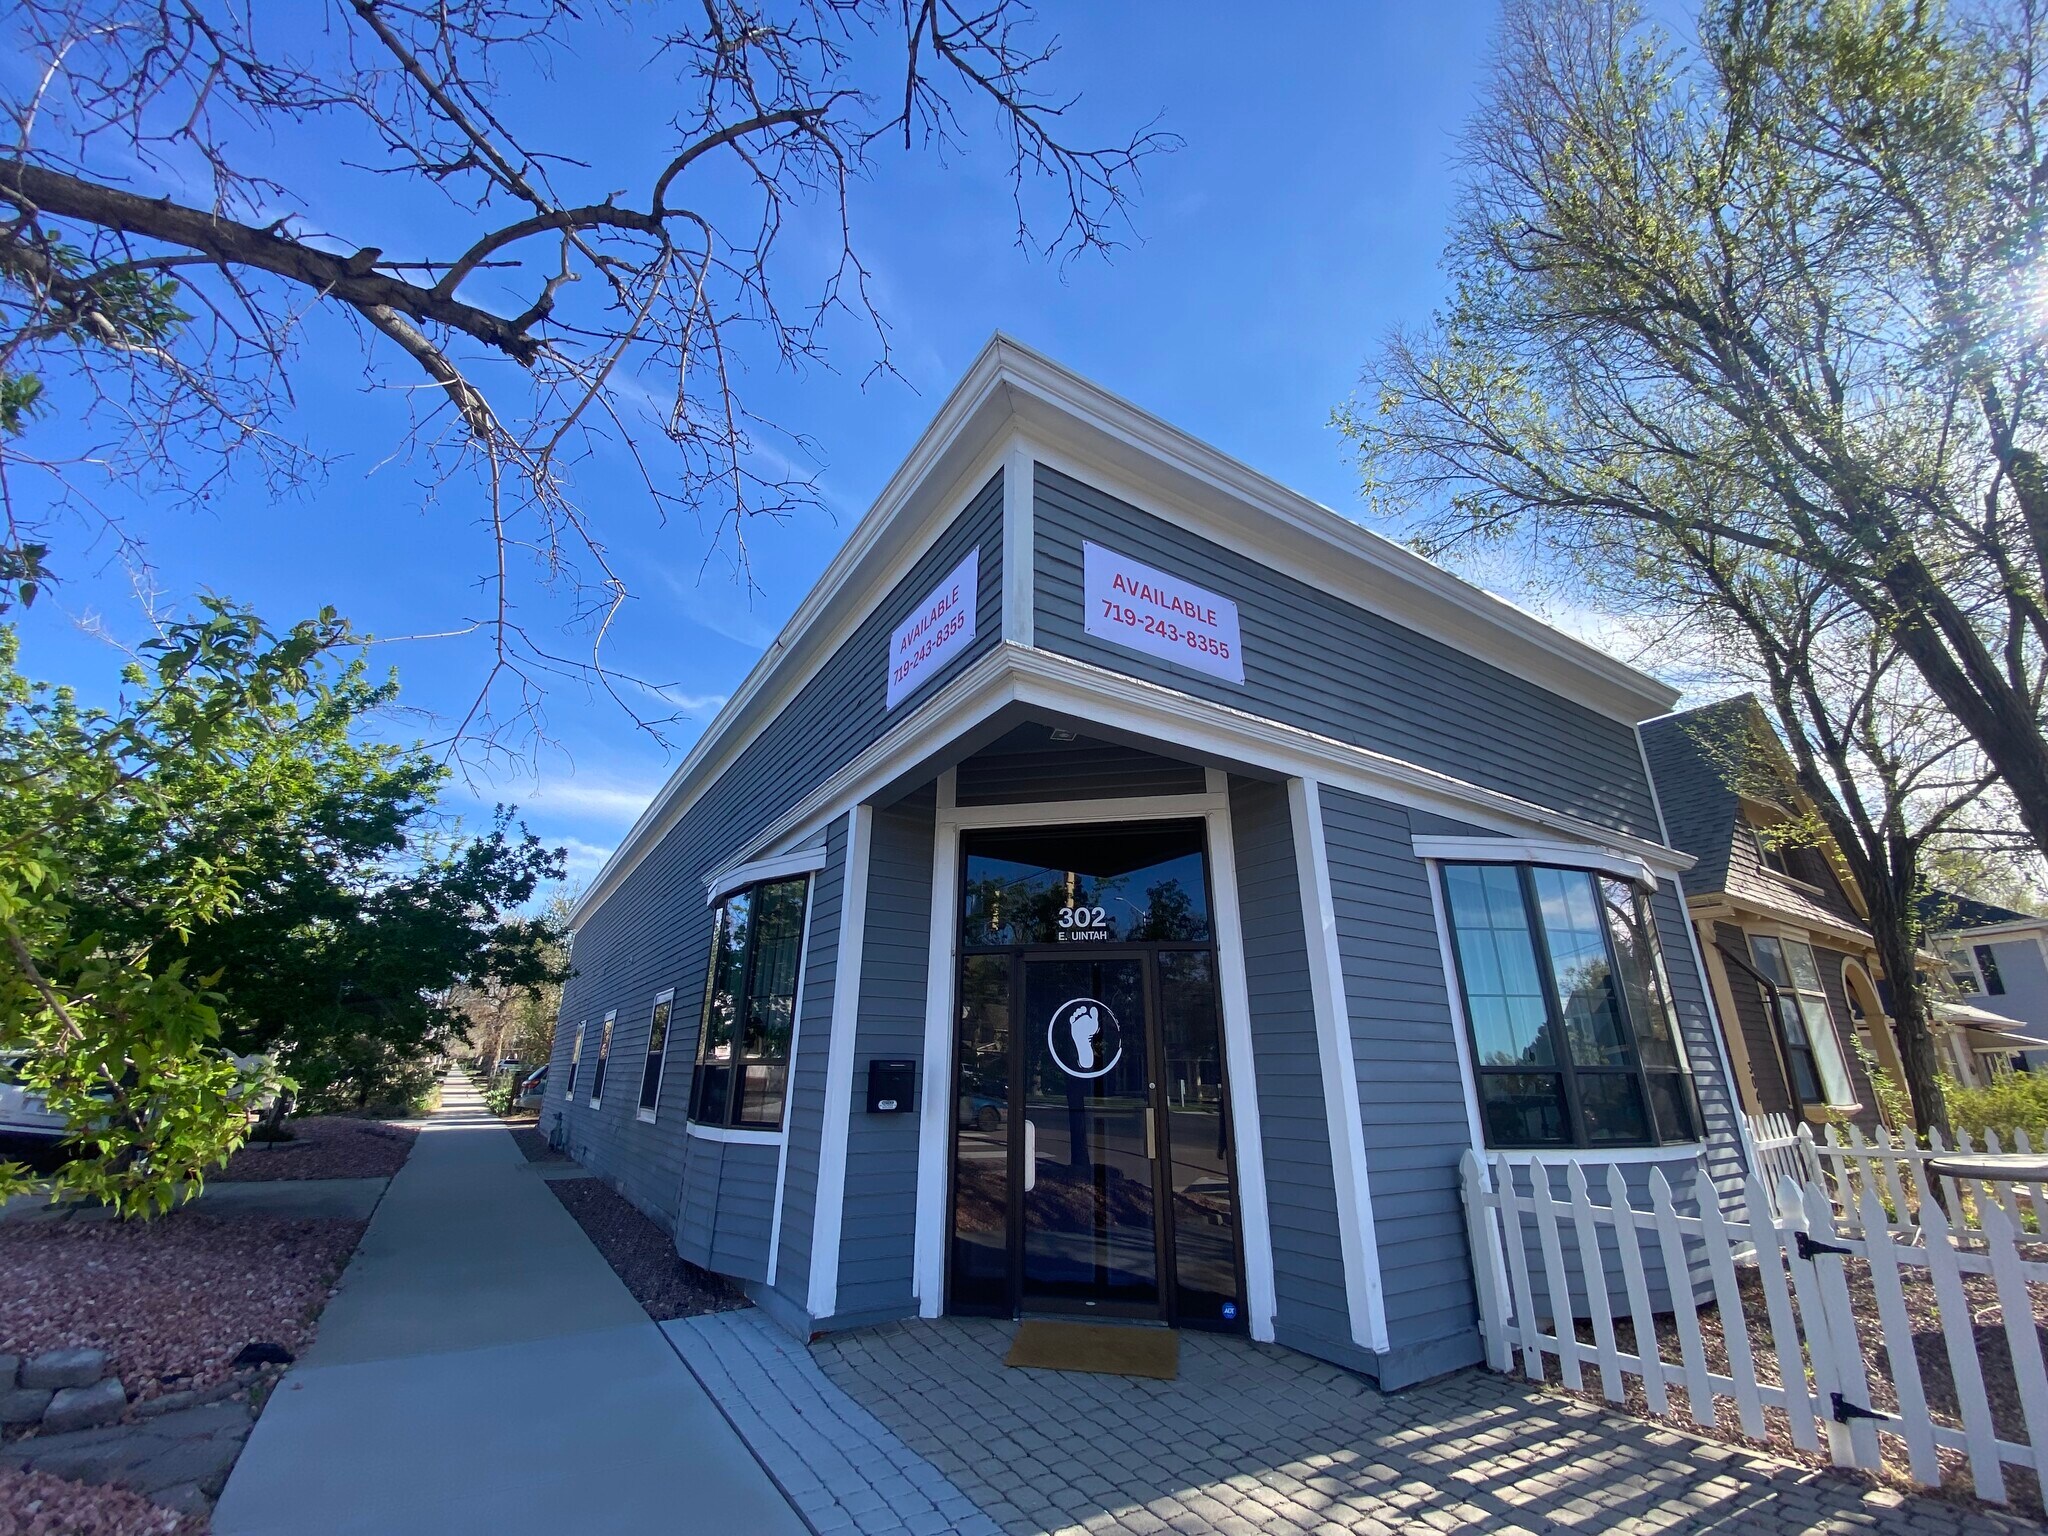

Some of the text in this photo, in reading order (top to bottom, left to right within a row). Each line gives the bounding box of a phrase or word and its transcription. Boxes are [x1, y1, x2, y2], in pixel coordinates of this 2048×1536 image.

[900, 584, 959, 655] AVAILABLE
[1101, 598, 1230, 659] 719-243-8355
[1112, 573, 1218, 628] AVAILABLE
[893, 609, 965, 687] 719-243-8355
[1058, 907, 1106, 928] 302
[1058, 931, 1107, 941] E. UINTAH
